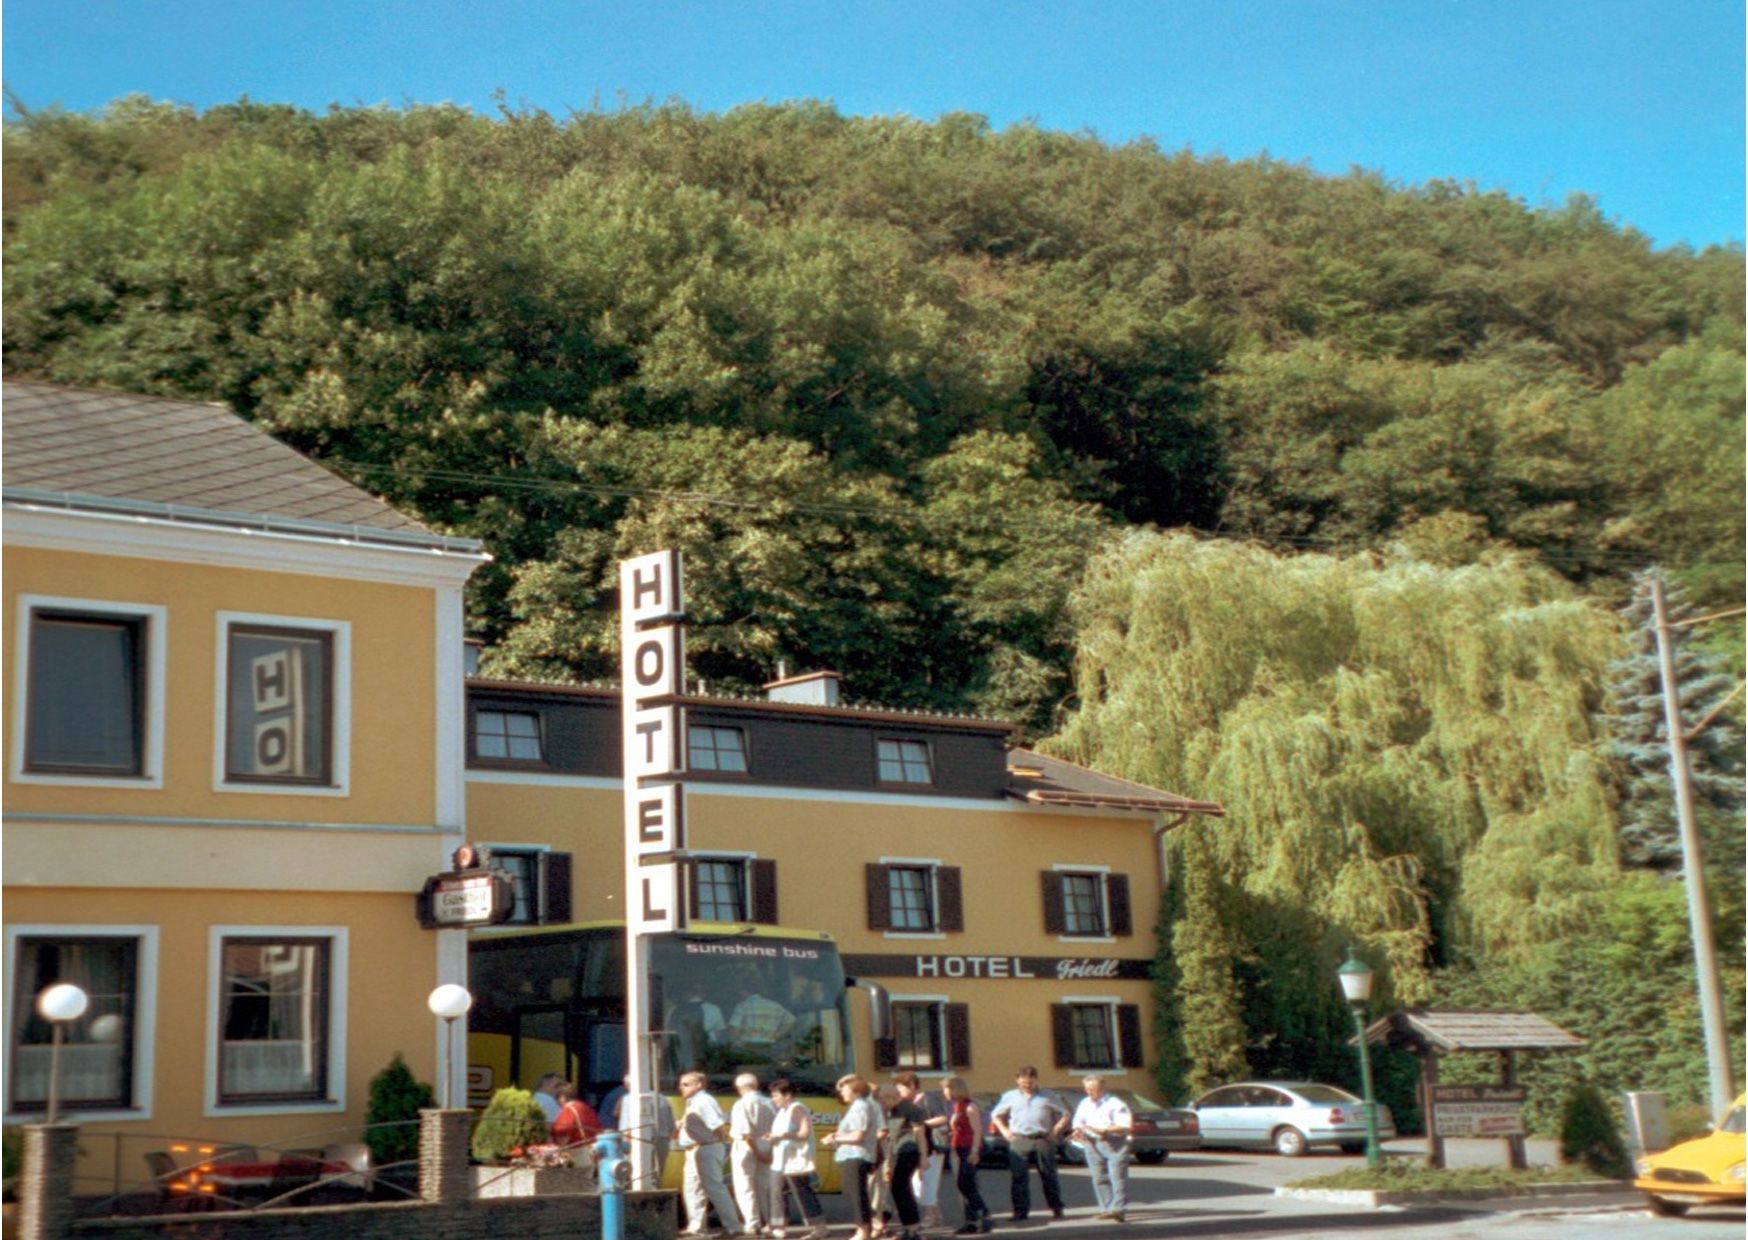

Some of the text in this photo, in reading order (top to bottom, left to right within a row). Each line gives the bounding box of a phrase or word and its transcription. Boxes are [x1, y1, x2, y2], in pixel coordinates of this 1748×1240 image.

[633, 563, 667, 922] HOTEL
[684, 943, 819, 959] sunshine bus
[915, 955, 1120, 980] HOTEL Friedl
